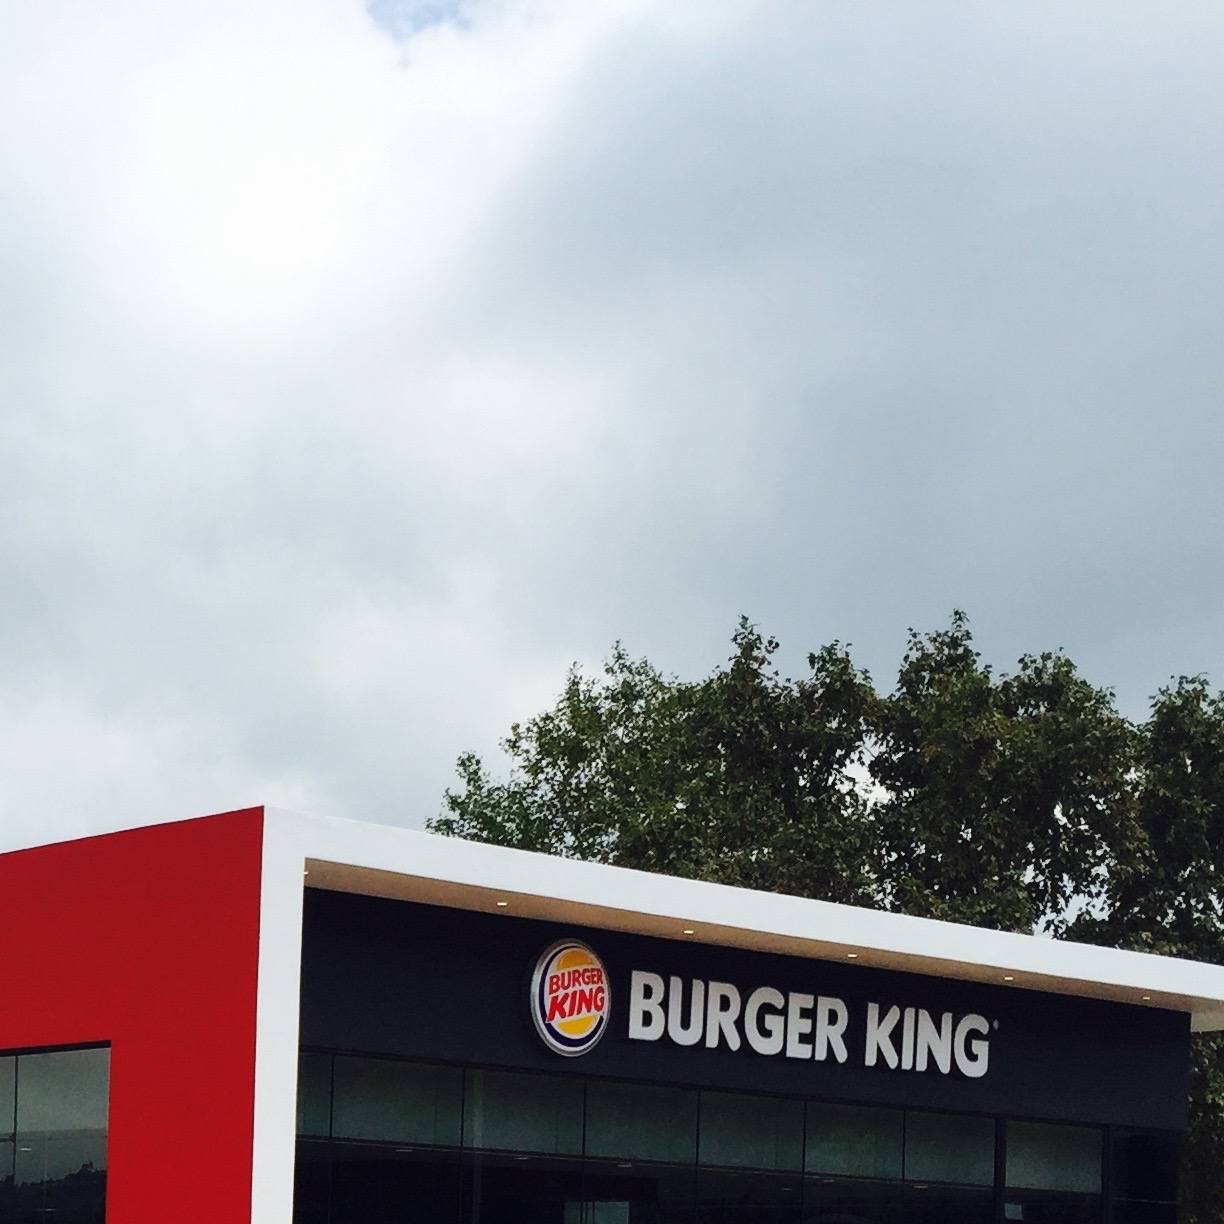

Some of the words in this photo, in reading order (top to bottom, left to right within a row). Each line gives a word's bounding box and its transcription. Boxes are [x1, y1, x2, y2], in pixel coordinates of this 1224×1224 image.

[549, 967, 604, 995] BURGER
[546, 986, 605, 1023] KING
[628, 970, 849, 1065] BURGER
[864, 1002, 990, 1078] KING
